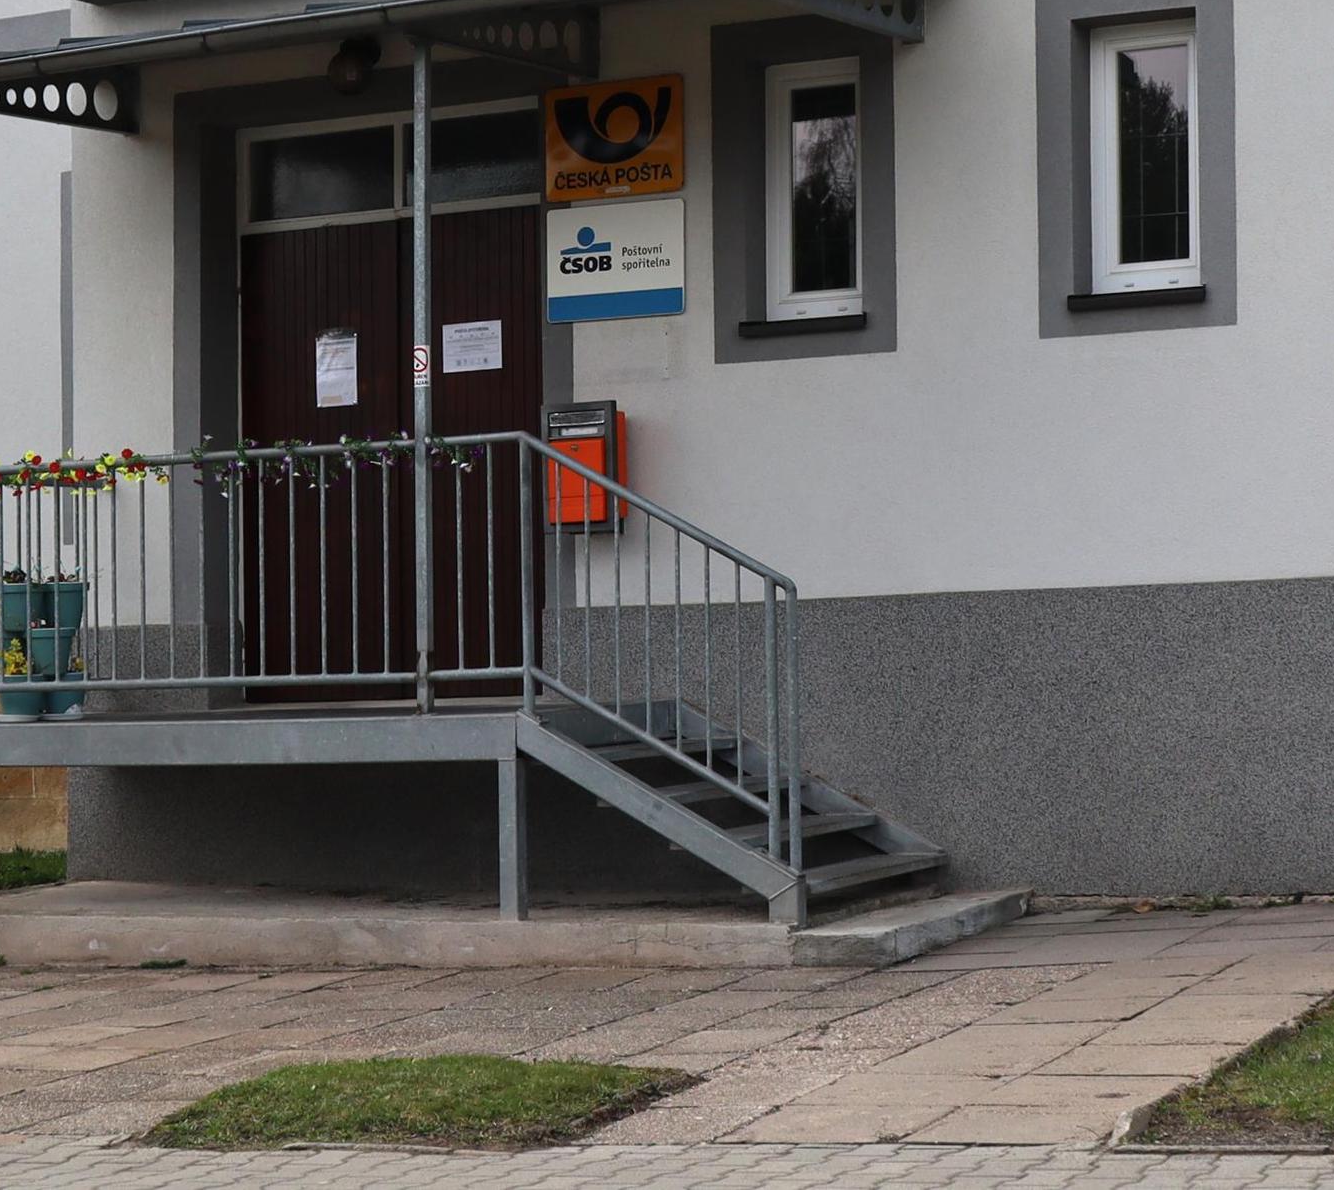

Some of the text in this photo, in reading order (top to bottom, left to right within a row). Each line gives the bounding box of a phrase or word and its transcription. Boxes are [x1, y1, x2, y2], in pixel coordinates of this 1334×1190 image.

[554, 162, 673, 190] ČESKÁ POŠTA
[621, 243, 663, 257] Poštovní
[560, 255, 612, 275] ČSOB
[621, 257, 671, 272] spořitelna
